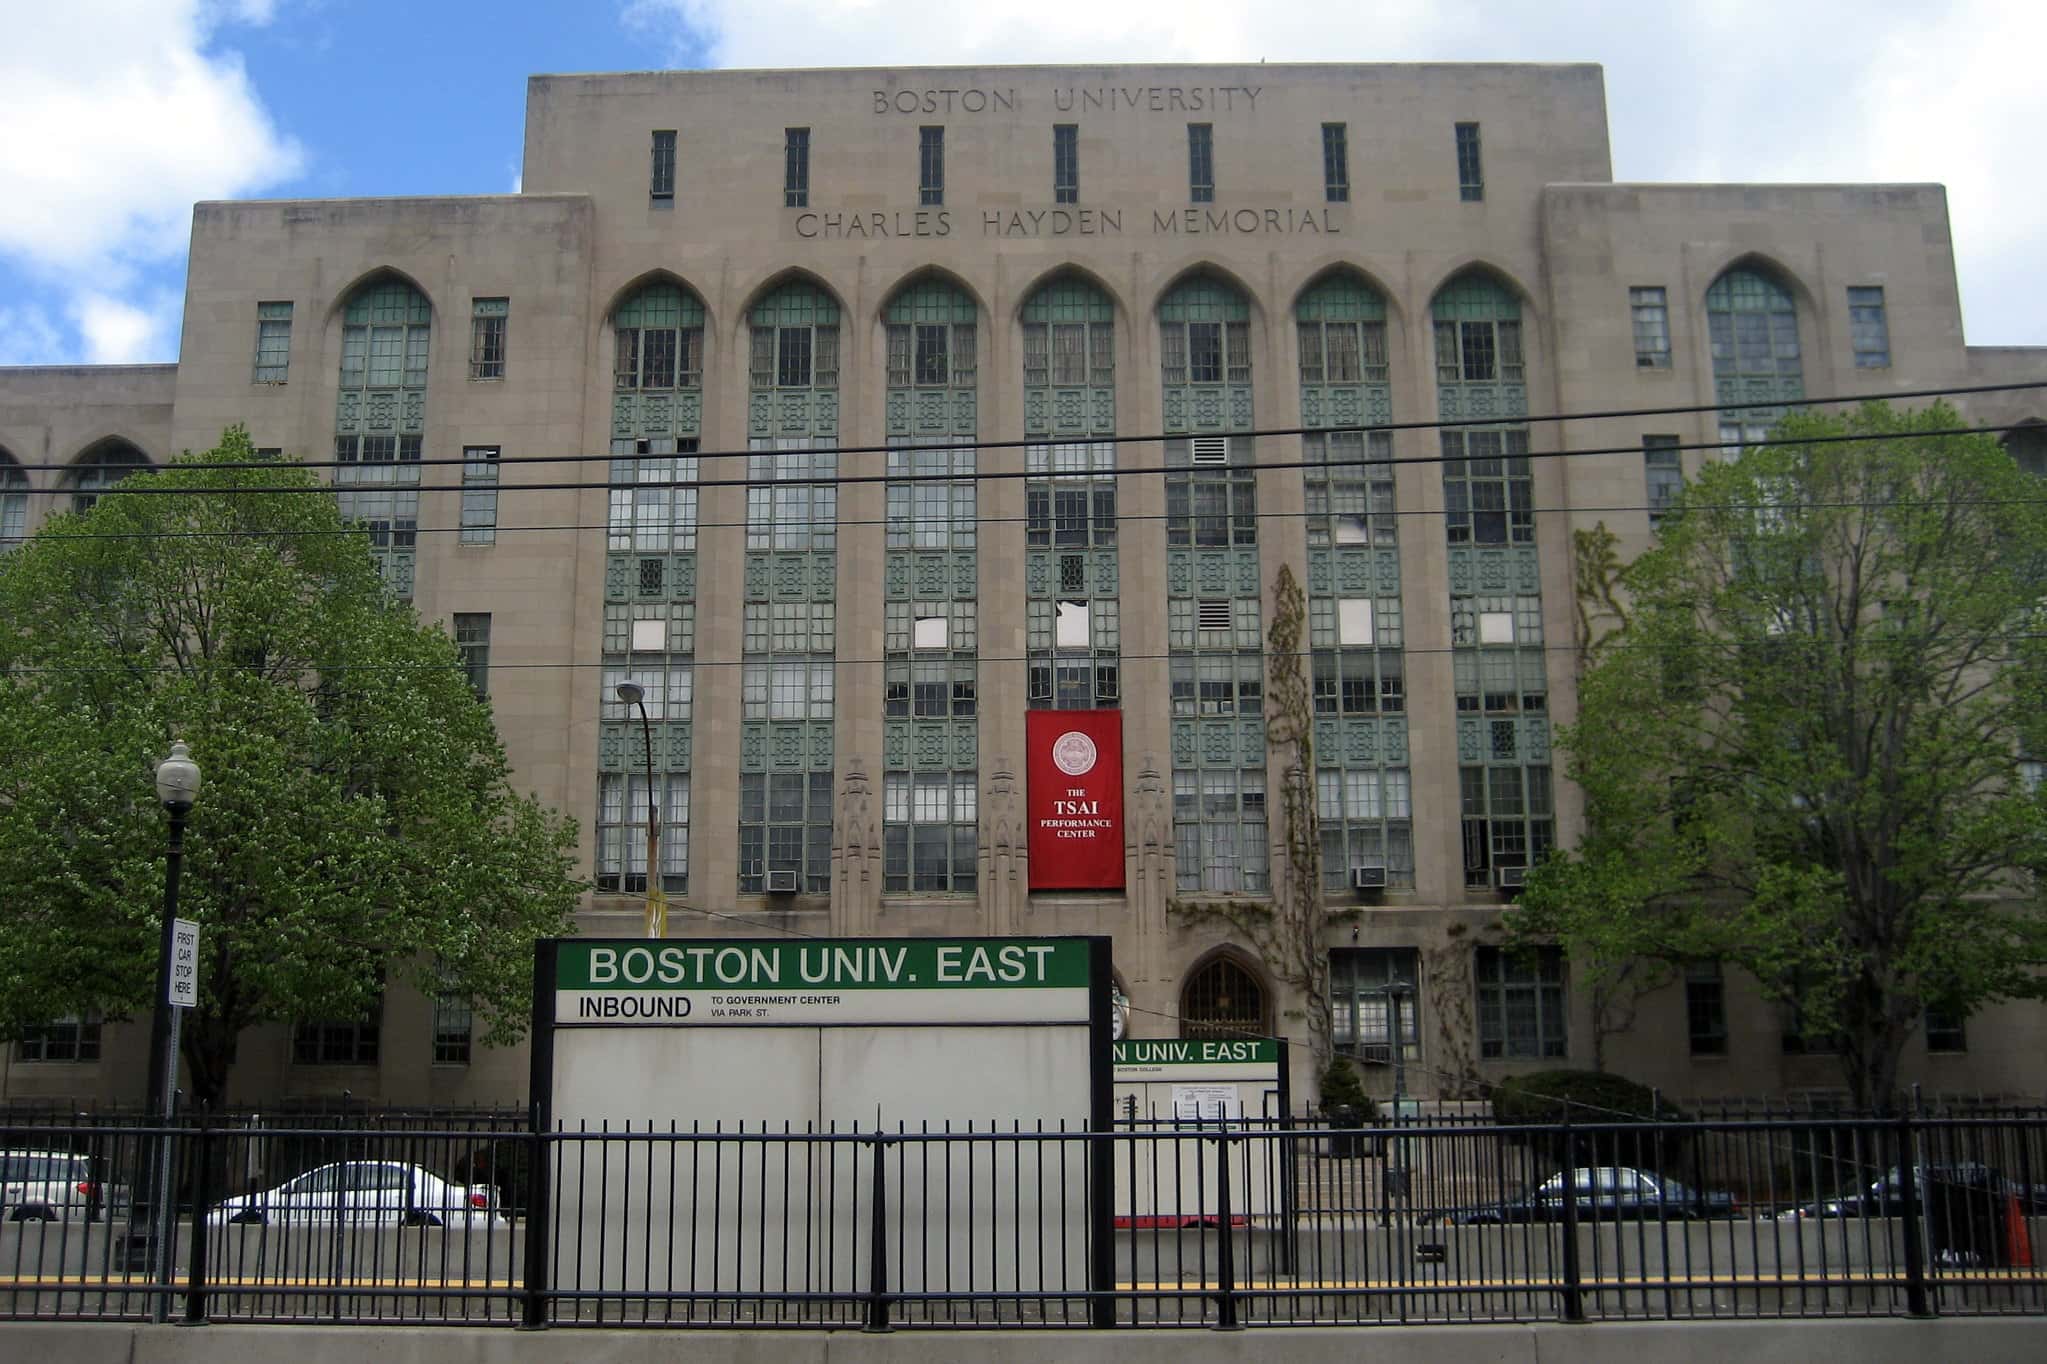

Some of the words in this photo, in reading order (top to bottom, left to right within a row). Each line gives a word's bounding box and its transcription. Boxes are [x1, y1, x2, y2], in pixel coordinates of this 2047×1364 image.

[872, 89, 1015, 114] BOSTON
[1054, 86, 1263, 112] UNIVERSITY
[795, 210, 952, 239] CHARLES
[982, 209, 1122, 236] HAYDEN
[1152, 208, 1340, 234] MEMORIAL
[1066, 789, 1085, 797] THE
[1054, 801, 1098, 815] TSAI
[1040, 819, 1112, 827] PERFORMANCE
[1057, 830, 1096, 838] CENTER
[177, 932, 194, 945] FIRST
[178, 948, 192, 960] CAR
[175, 964, 192, 977] STOP
[589, 947, 781, 984] BOSTON
[799, 947, 917, 983] UNIV.
[936, 945, 1055, 982] EAST
[174, 981, 191, 994] HERE
[711, 996, 723, 1004] TO
[726, 995, 797, 1004] GOVERNMENT
[800, 995, 840, 1004] CENTER
[579, 996, 692, 1018] INBOUND
[711, 1008, 726, 1017] VIA
[729, 1008, 753, 1017] PARK
[756, 1008, 769, 1017] ST.
[1135, 1043, 1194, 1061] UNIV.
[1203, 1042, 1261, 1060] EAST
